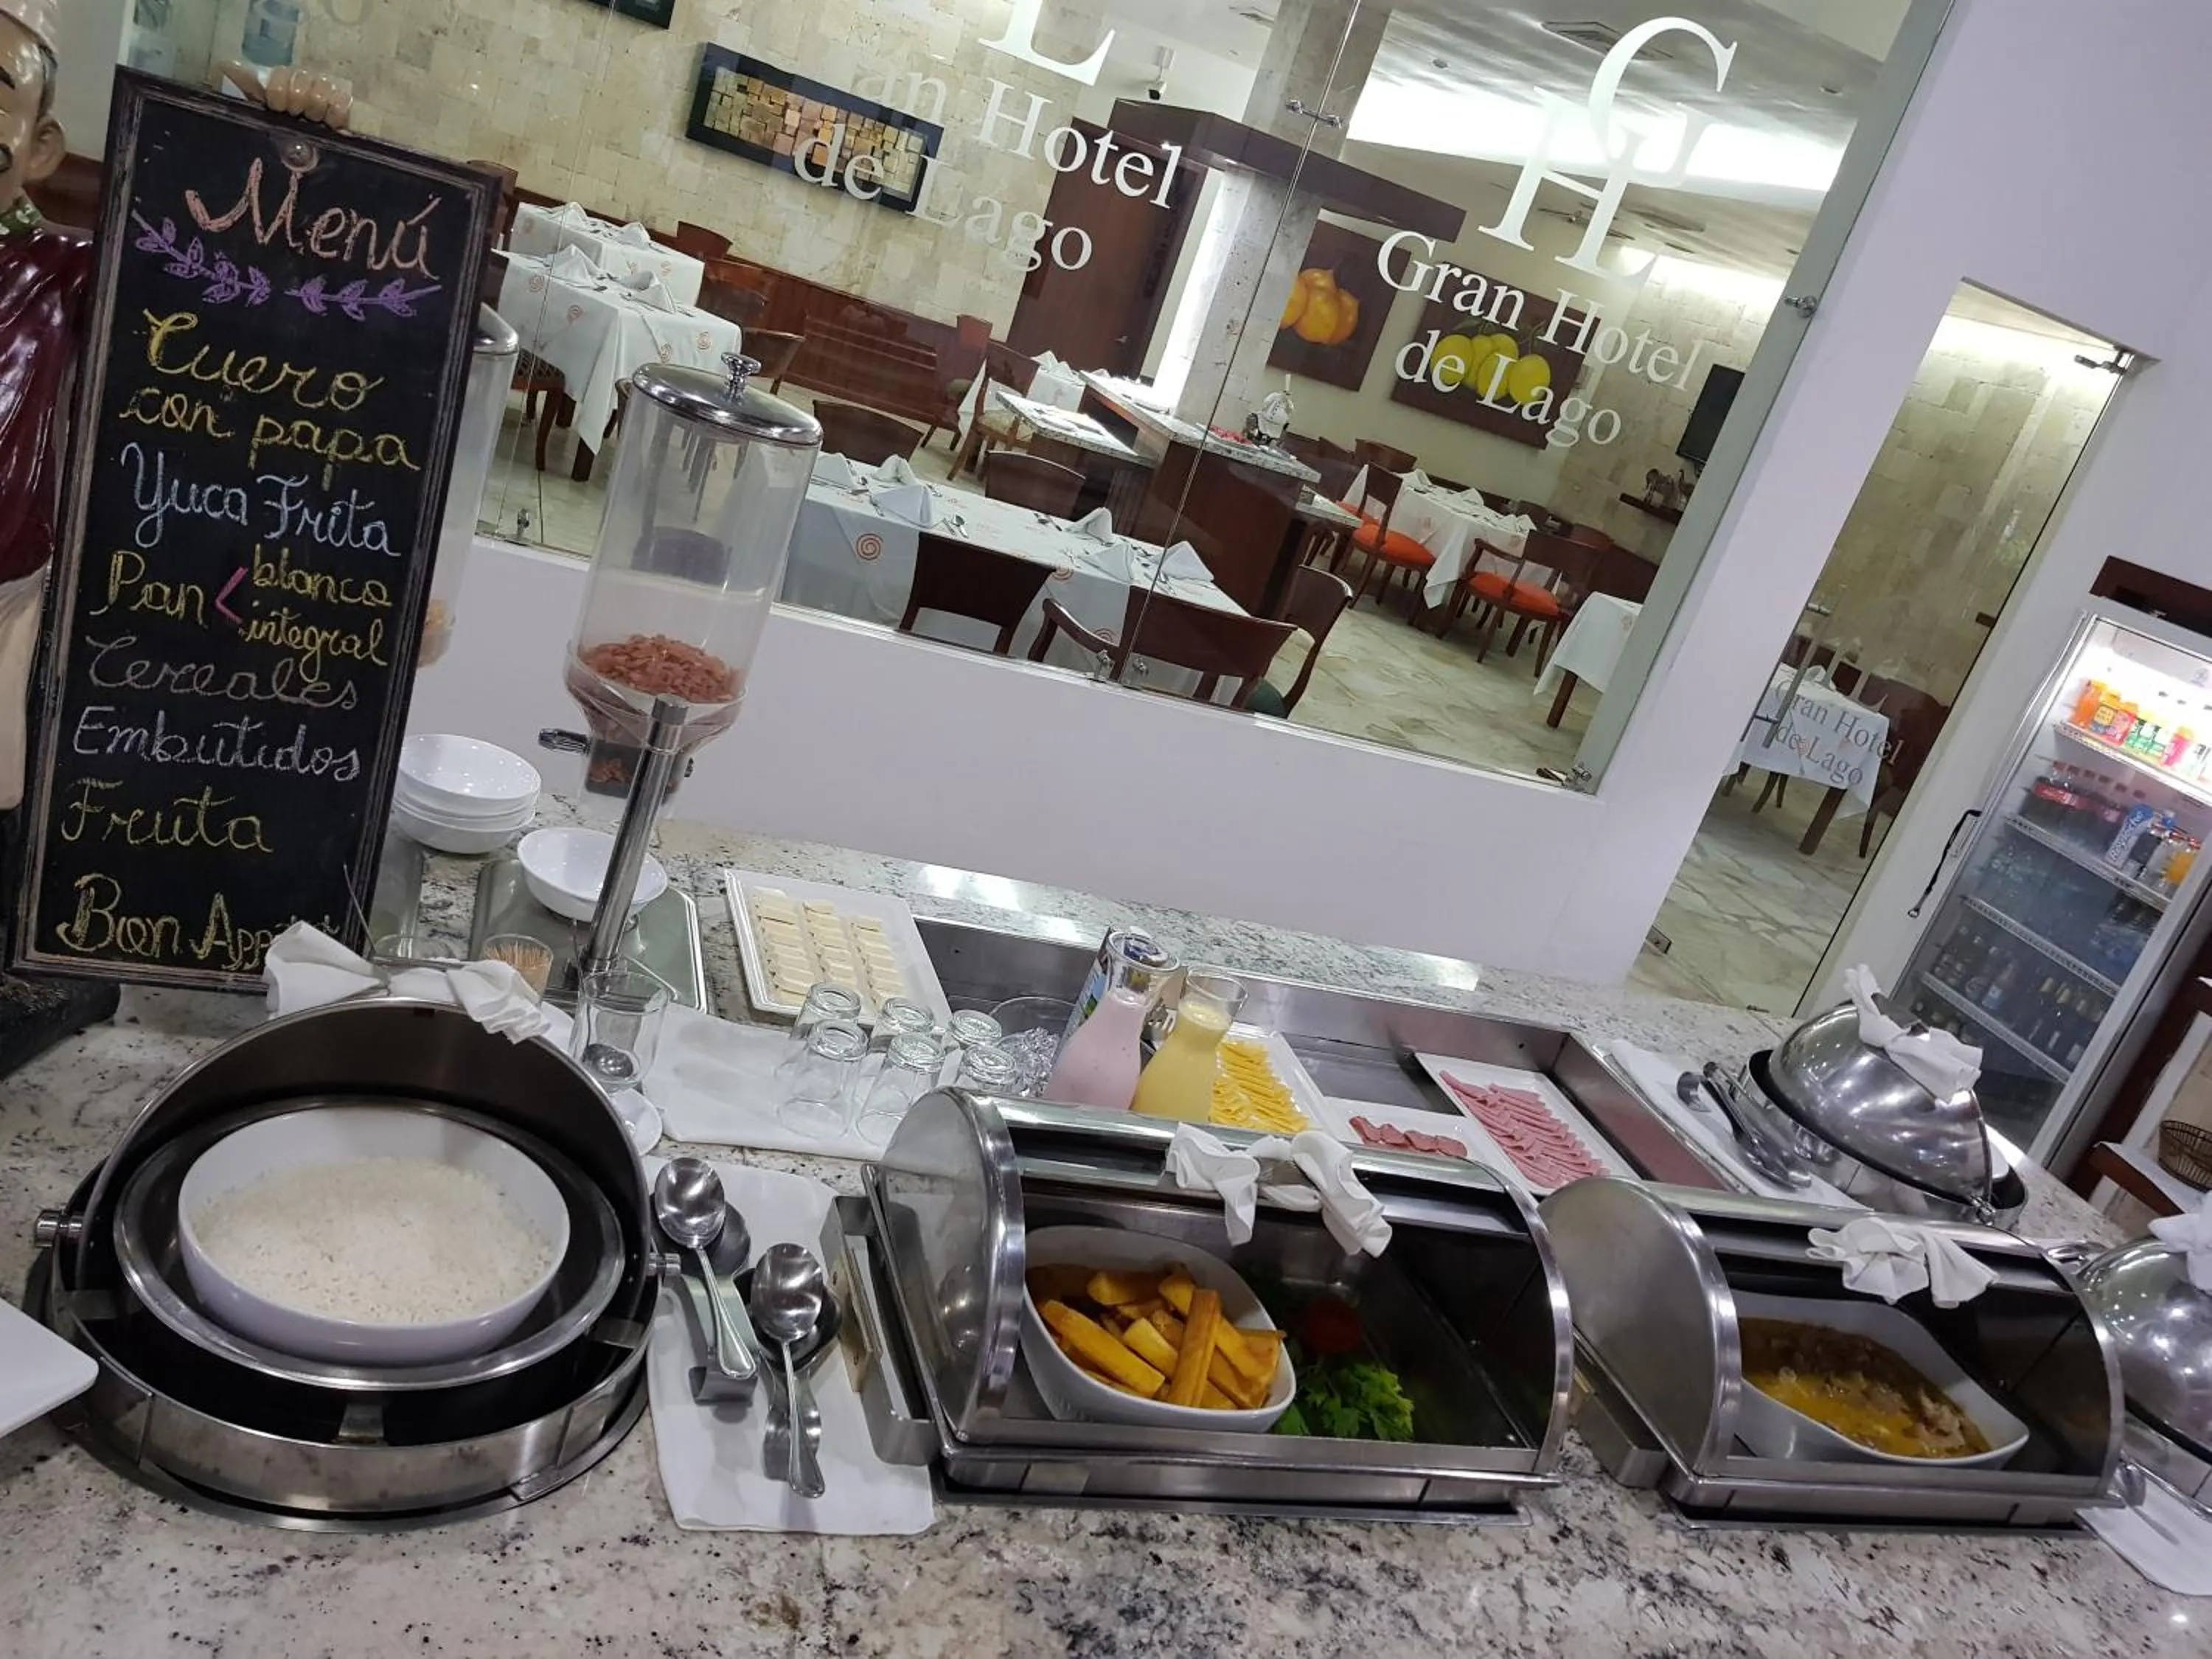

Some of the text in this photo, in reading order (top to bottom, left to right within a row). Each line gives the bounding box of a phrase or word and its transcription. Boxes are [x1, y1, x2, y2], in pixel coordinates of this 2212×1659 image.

[972, 77, 1183, 209] Hotel
[185, 157, 441, 280] Menú
[793, 123, 1093, 272] de Lago
[1377, 230, 1705, 392] Gran Hotel
[142, 309, 384, 411] Cuero
[1394, 330, 1621, 448] de Lago
[119, 387, 420, 491] con papa
[256, 475, 401, 556] Frita
[90, 552, 207, 628] Pan
[85, 635, 357, 711] Cereales
[239, 599, 388, 683] integral
[74, 706, 361, 782] Embutidos
[1775, 721, 1863, 786] de Lago
[1834, 709, 1905, 766] Hotel
[56, 873, 183, 958] Bon
